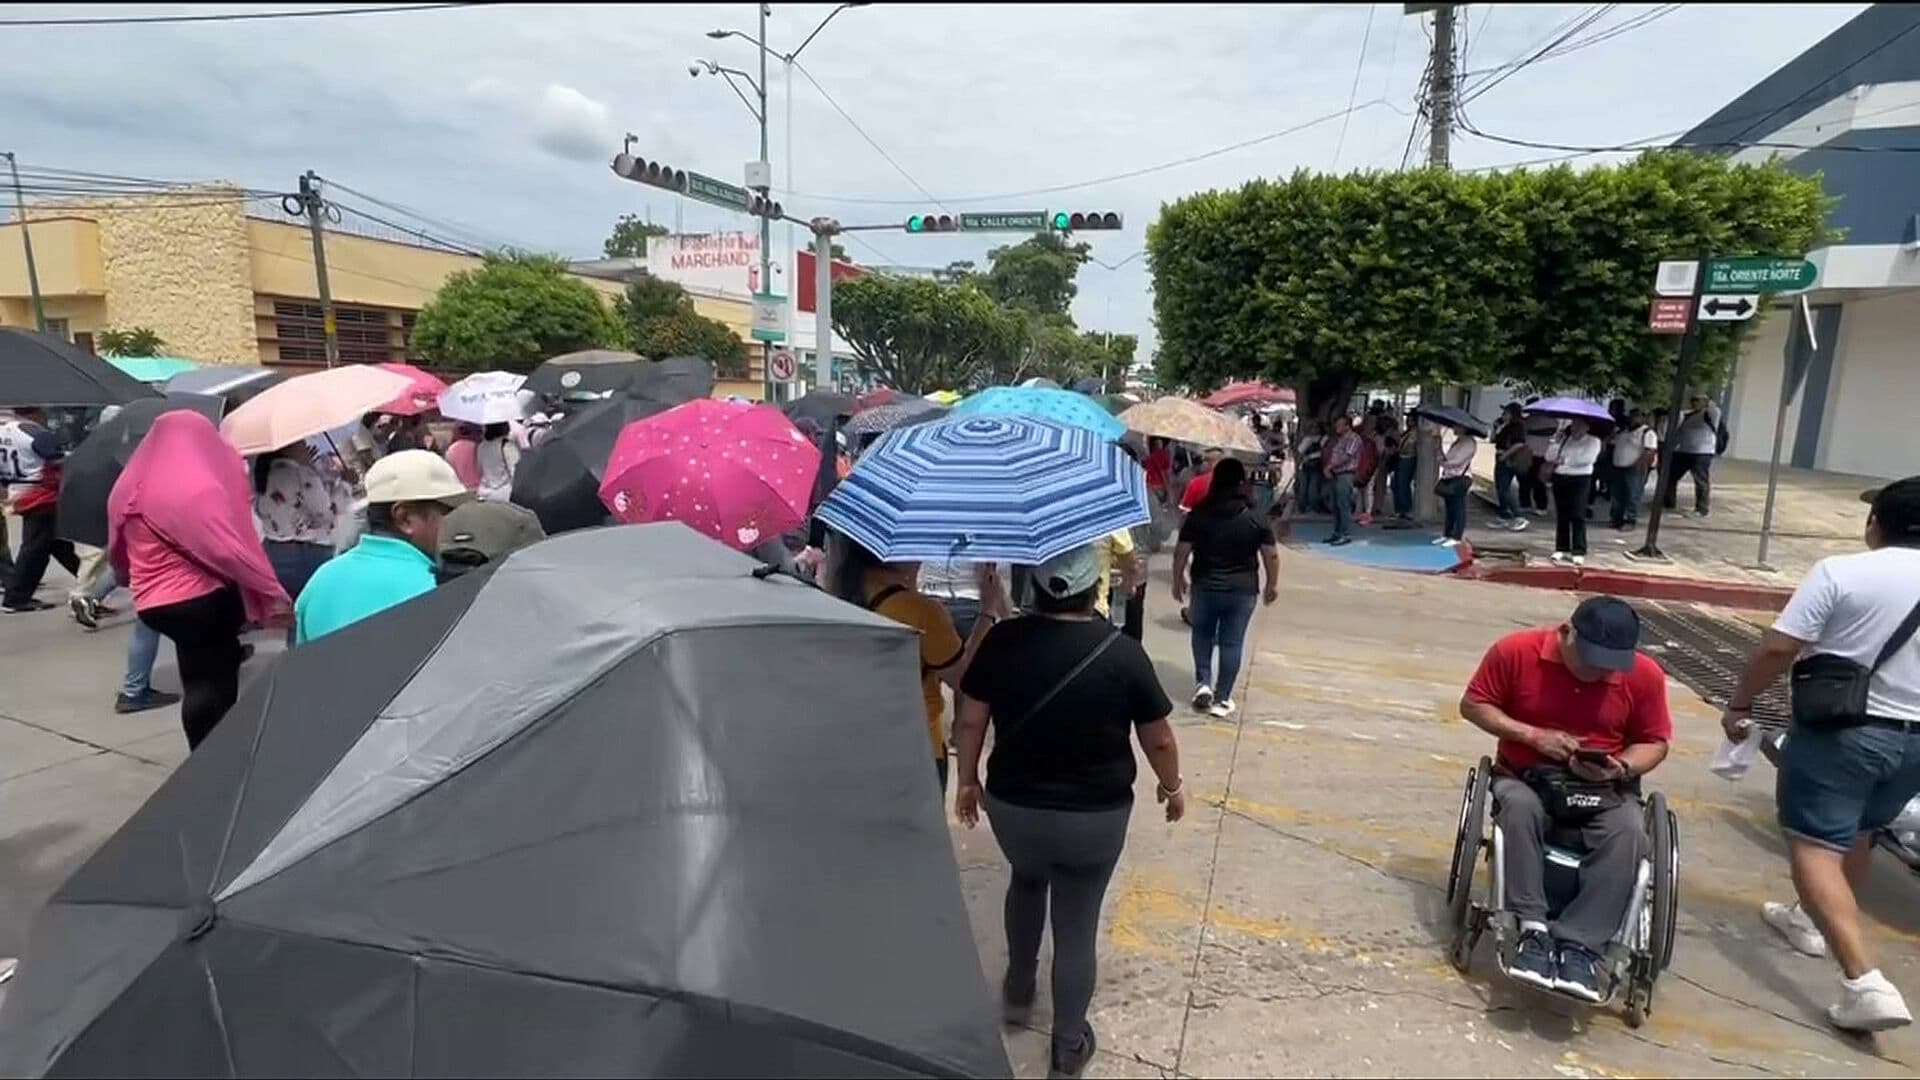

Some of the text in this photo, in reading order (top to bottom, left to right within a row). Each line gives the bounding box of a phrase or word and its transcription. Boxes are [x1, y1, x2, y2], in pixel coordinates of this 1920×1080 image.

[671, 251, 750, 270] MARCHAND
[1730, 268, 1770, 282] ORIENTE
[1770, 267, 1801, 281] NORTE
